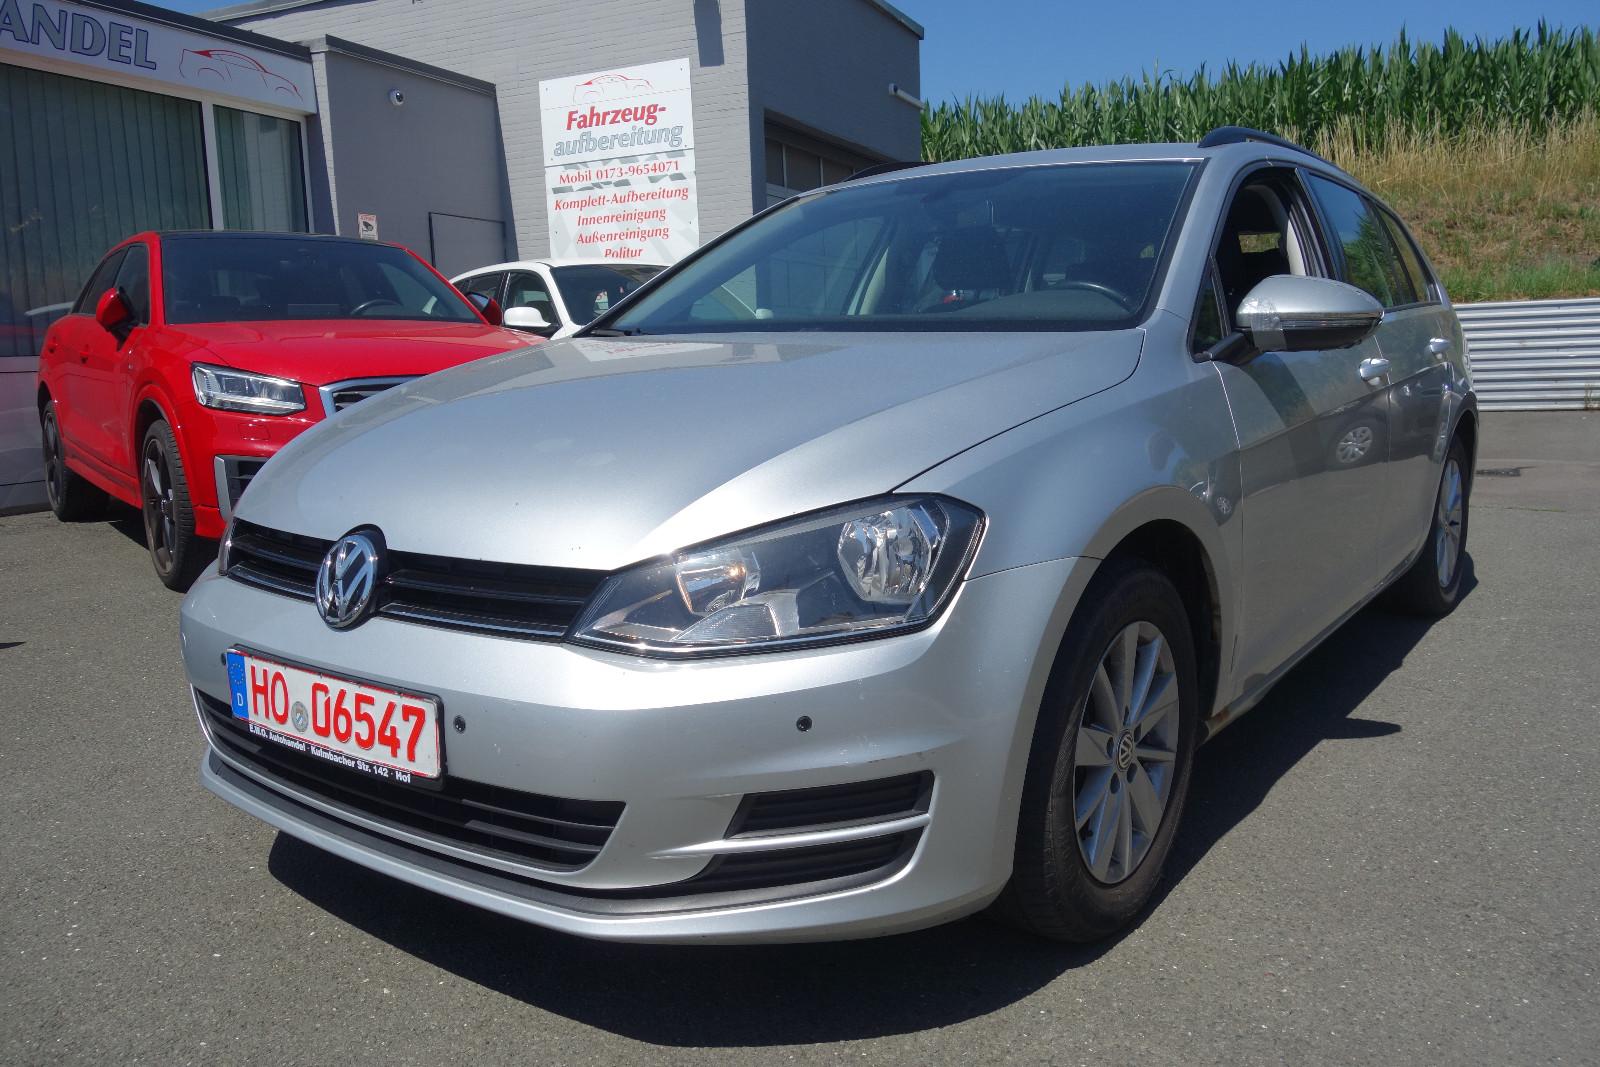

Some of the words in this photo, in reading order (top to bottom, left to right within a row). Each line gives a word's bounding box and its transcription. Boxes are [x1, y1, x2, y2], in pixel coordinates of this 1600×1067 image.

[566, 103, 667, 130] Fahrzeug-
[554, 125, 684, 156] aufbereitung
[559, 172, 592, 184] Mobil
[596, 160, 680, 179] 0173-9654071
[554, 187, 689, 210] Komplett-Aufbereitung
[577, 208, 666, 226] Innenreinigung
[576, 227, 670, 244] Außenreinigung
[604, 247, 643, 258] Politur
[237, 693, 244, 707] D
[250, 665, 289, 725] HO
[311, 682, 426, 762] 06547
[269, 733, 306, 751] Autohandel
[357, 761, 371, 773] Str.
[373, 765, 389, 777] 142
[396, 770, 411, 783] Hof
